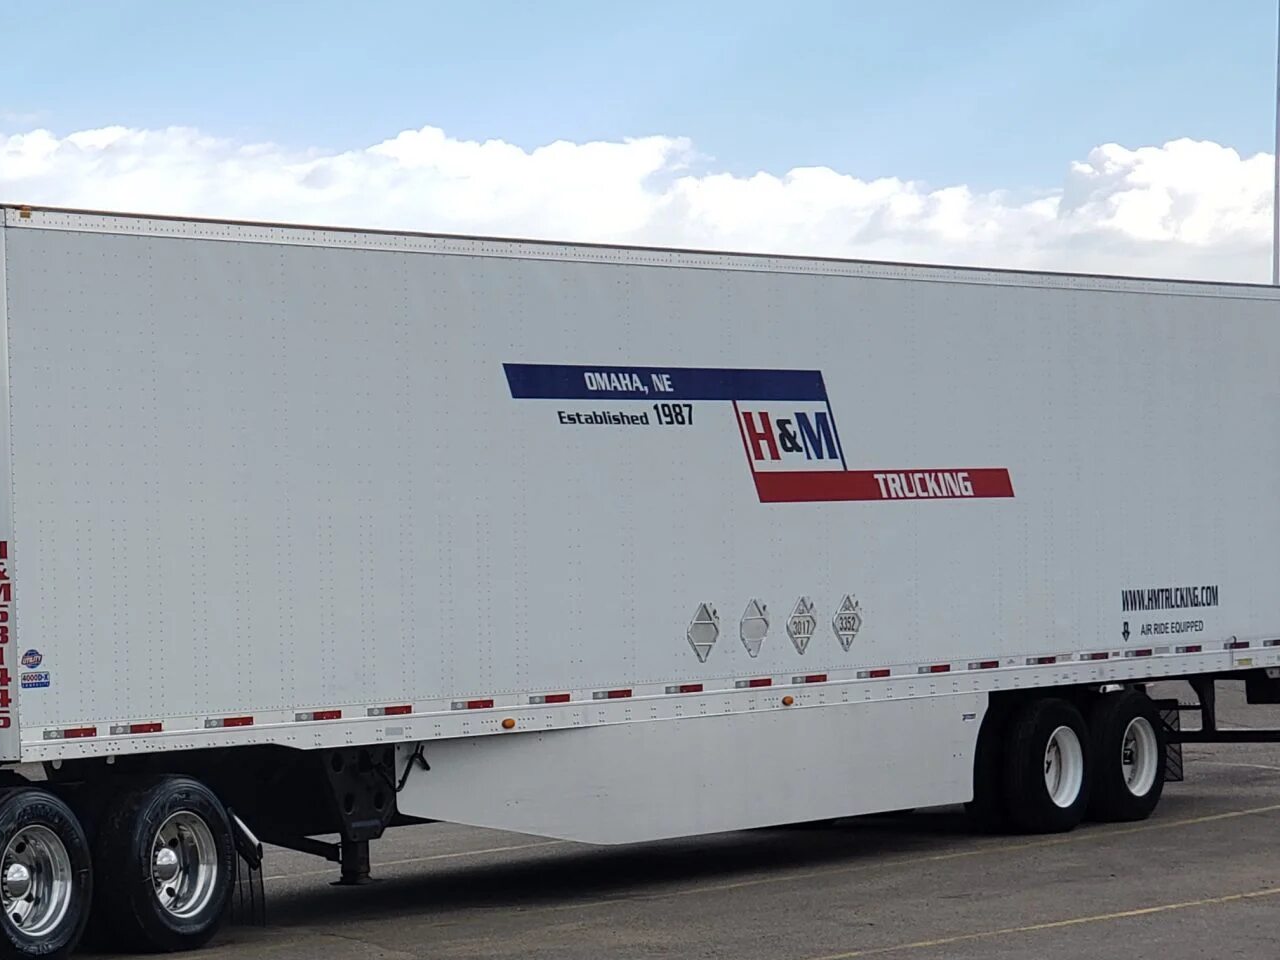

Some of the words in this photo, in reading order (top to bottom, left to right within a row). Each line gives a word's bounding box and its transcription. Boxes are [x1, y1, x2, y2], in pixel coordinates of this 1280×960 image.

[583, 371, 649, 395] OMAHA,
[651, 373, 674, 392] NE
[557, 410, 650, 426] Established
[653, 403, 693, 426] 1987
[741, 411, 839, 461] H&M
[873, 472, 974, 498] TRUCKING
[792, 619, 811, 635] 3017
[839, 616, 857, 632] 3352
[1140, 624, 1153, 636] AIR
[1153, 622, 1170, 635] RIDE
[1171, 620, 1204, 633] EQUIPPED
